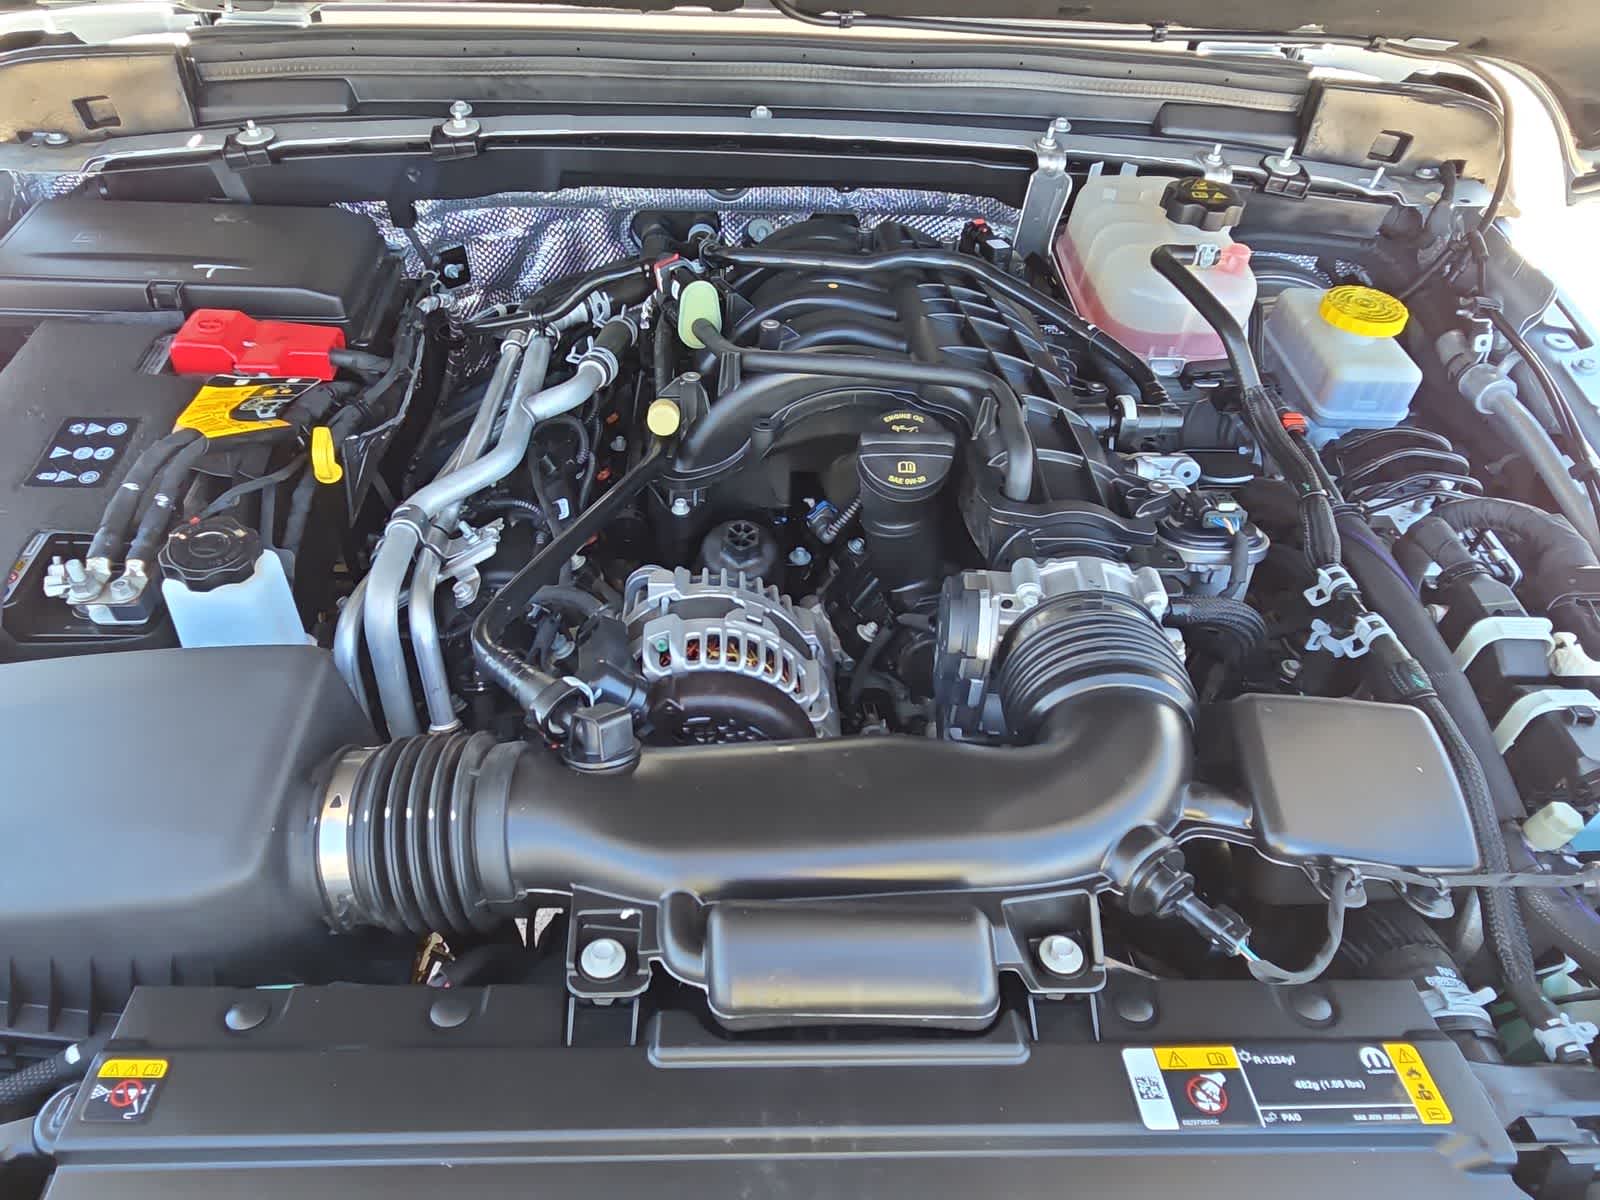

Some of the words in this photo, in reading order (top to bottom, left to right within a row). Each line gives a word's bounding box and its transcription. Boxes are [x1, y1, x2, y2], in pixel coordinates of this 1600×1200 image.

[883, 413, 911, 423] ENGINE
[912, 414, 925, 424] OIL
[887, 475, 904, 485] SAE
